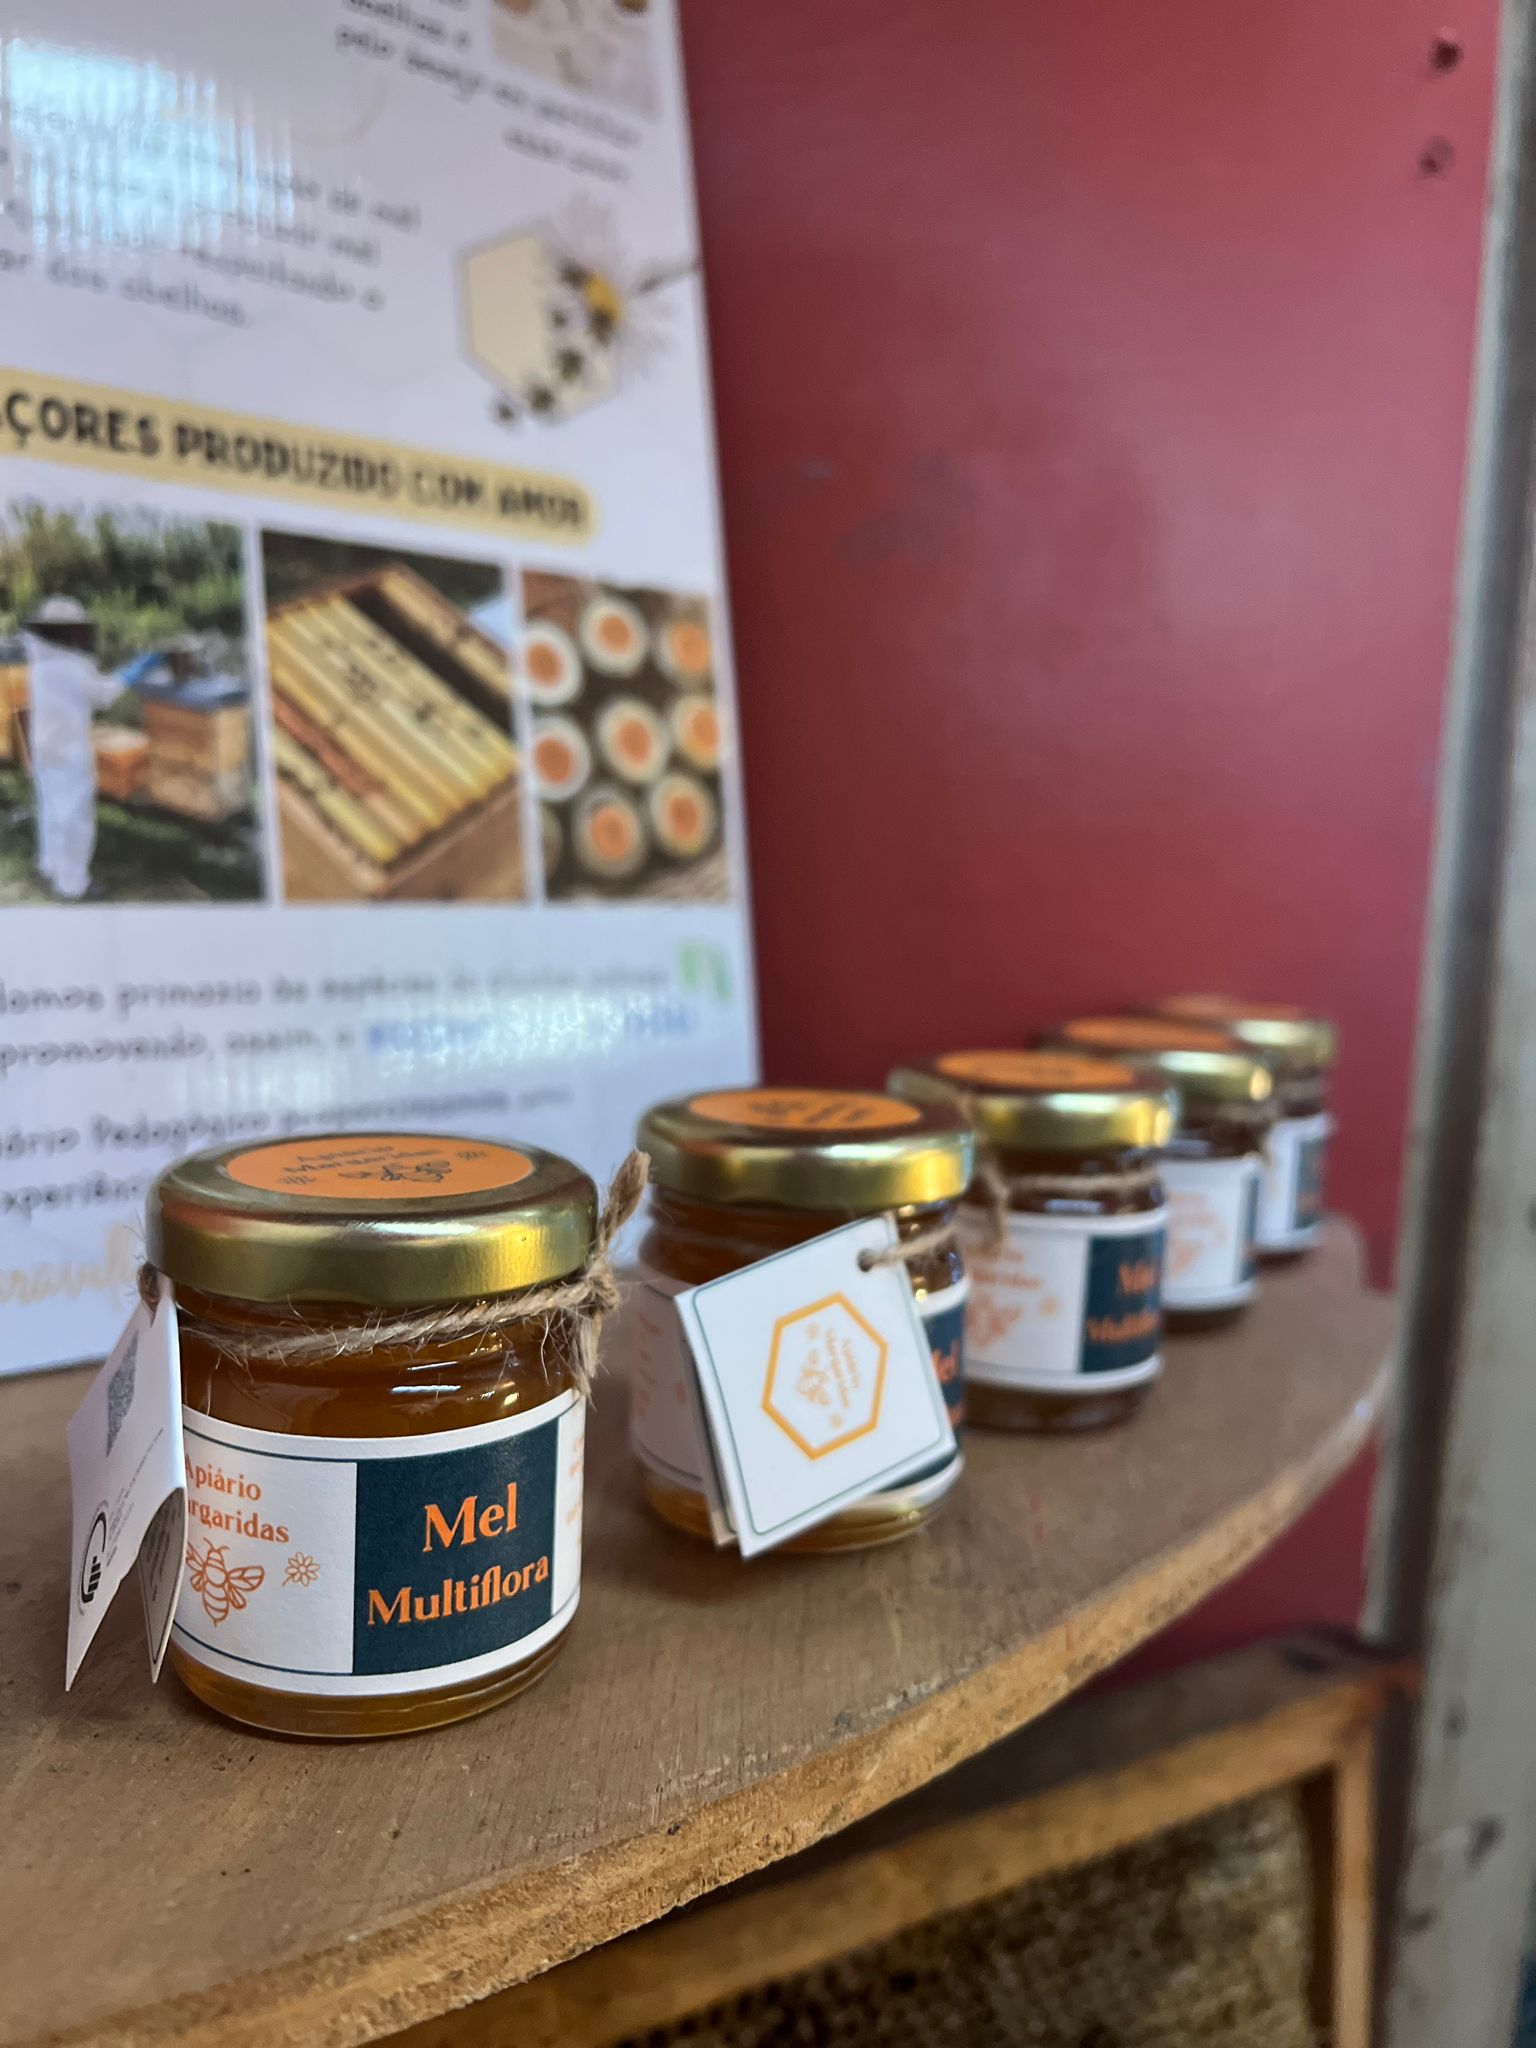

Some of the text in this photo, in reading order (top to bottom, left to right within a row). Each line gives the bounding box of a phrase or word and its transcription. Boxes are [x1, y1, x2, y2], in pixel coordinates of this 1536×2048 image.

[0, 390, 160, 458] ÇORES
[173, 418, 400, 500] PRODUZIDO
[188, 1498, 290, 1544] rgaridas
[422, 1481, 518, 1552] Mel
[367, 1554, 550, 1626] Multiflora
